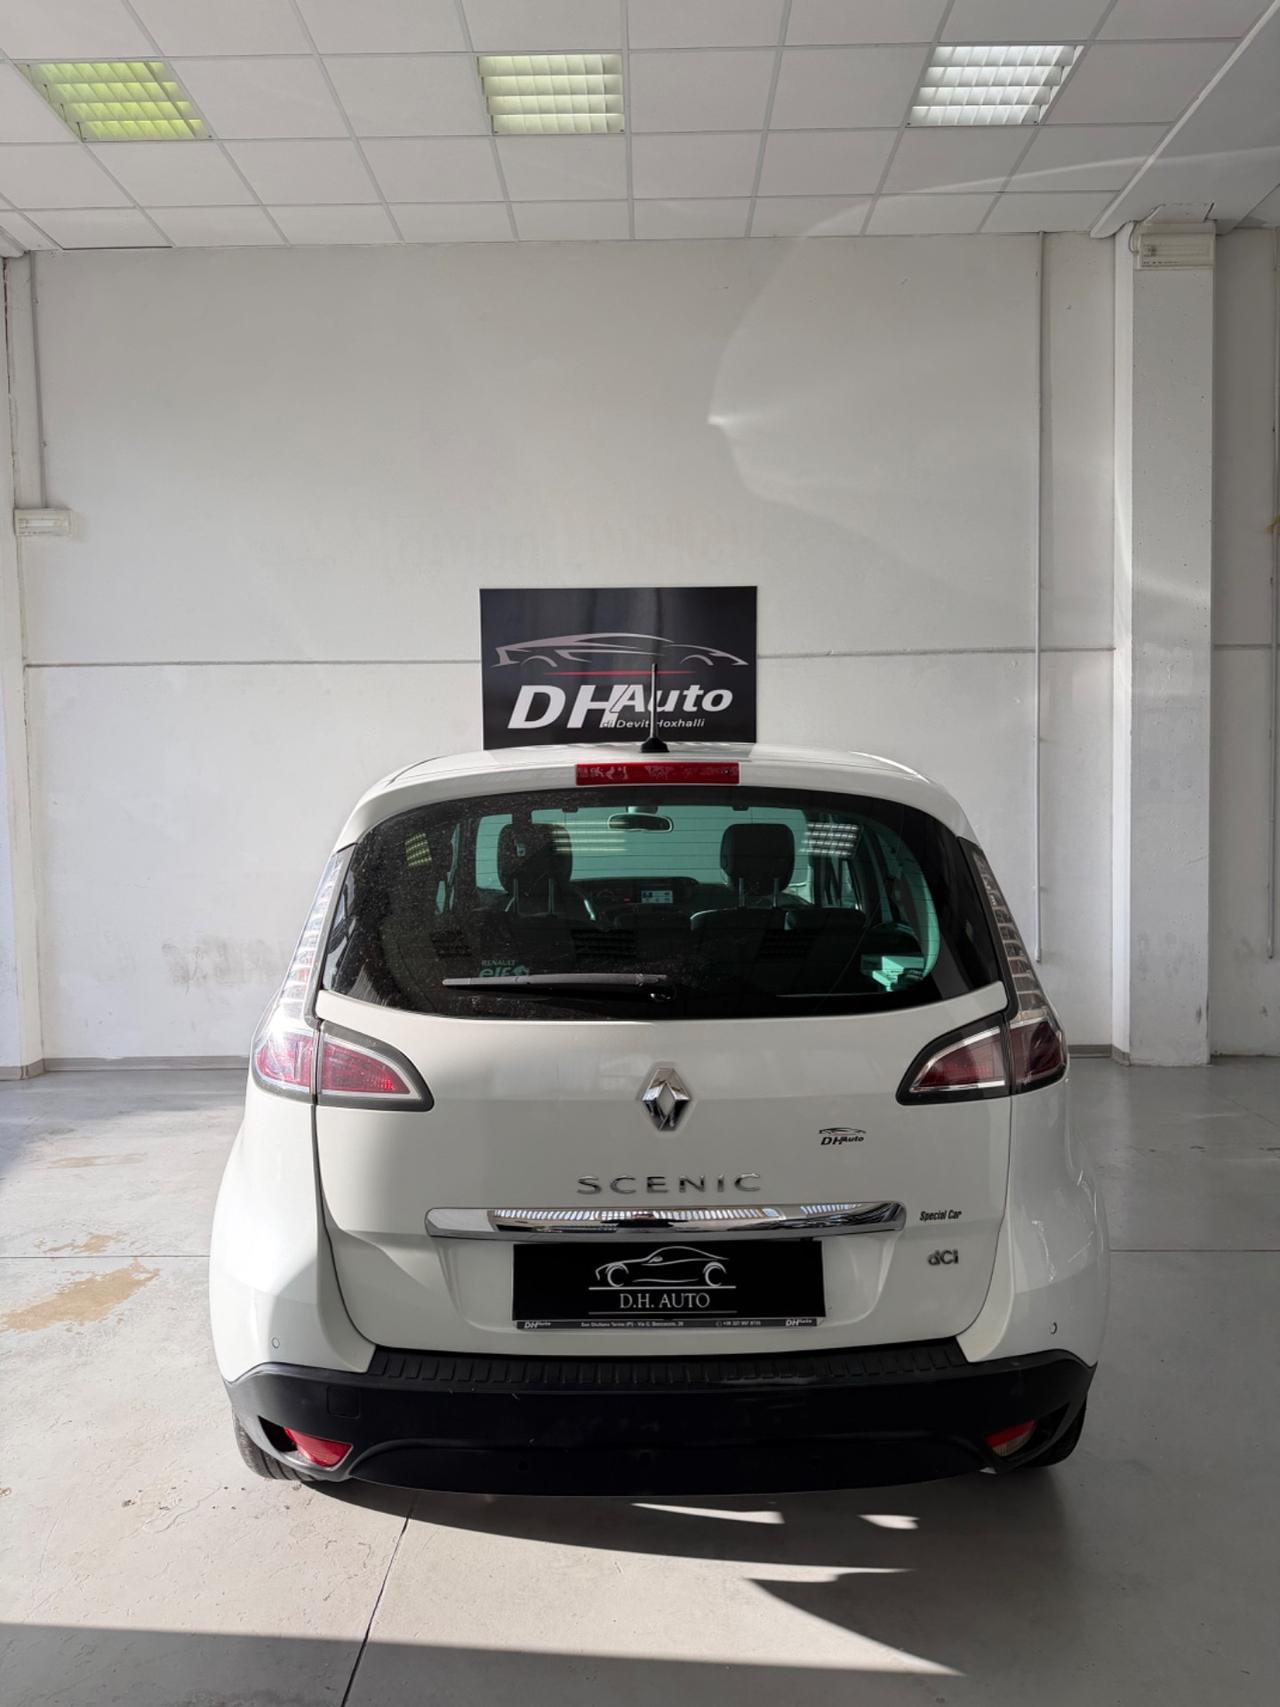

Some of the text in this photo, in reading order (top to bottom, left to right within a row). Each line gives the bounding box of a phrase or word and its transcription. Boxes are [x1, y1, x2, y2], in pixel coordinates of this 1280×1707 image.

[576, 1173, 761, 1195] SCENIC
[920, 1209, 962, 1222] Special Car
[619, 1292, 710, 1308] D.H. AUTO
